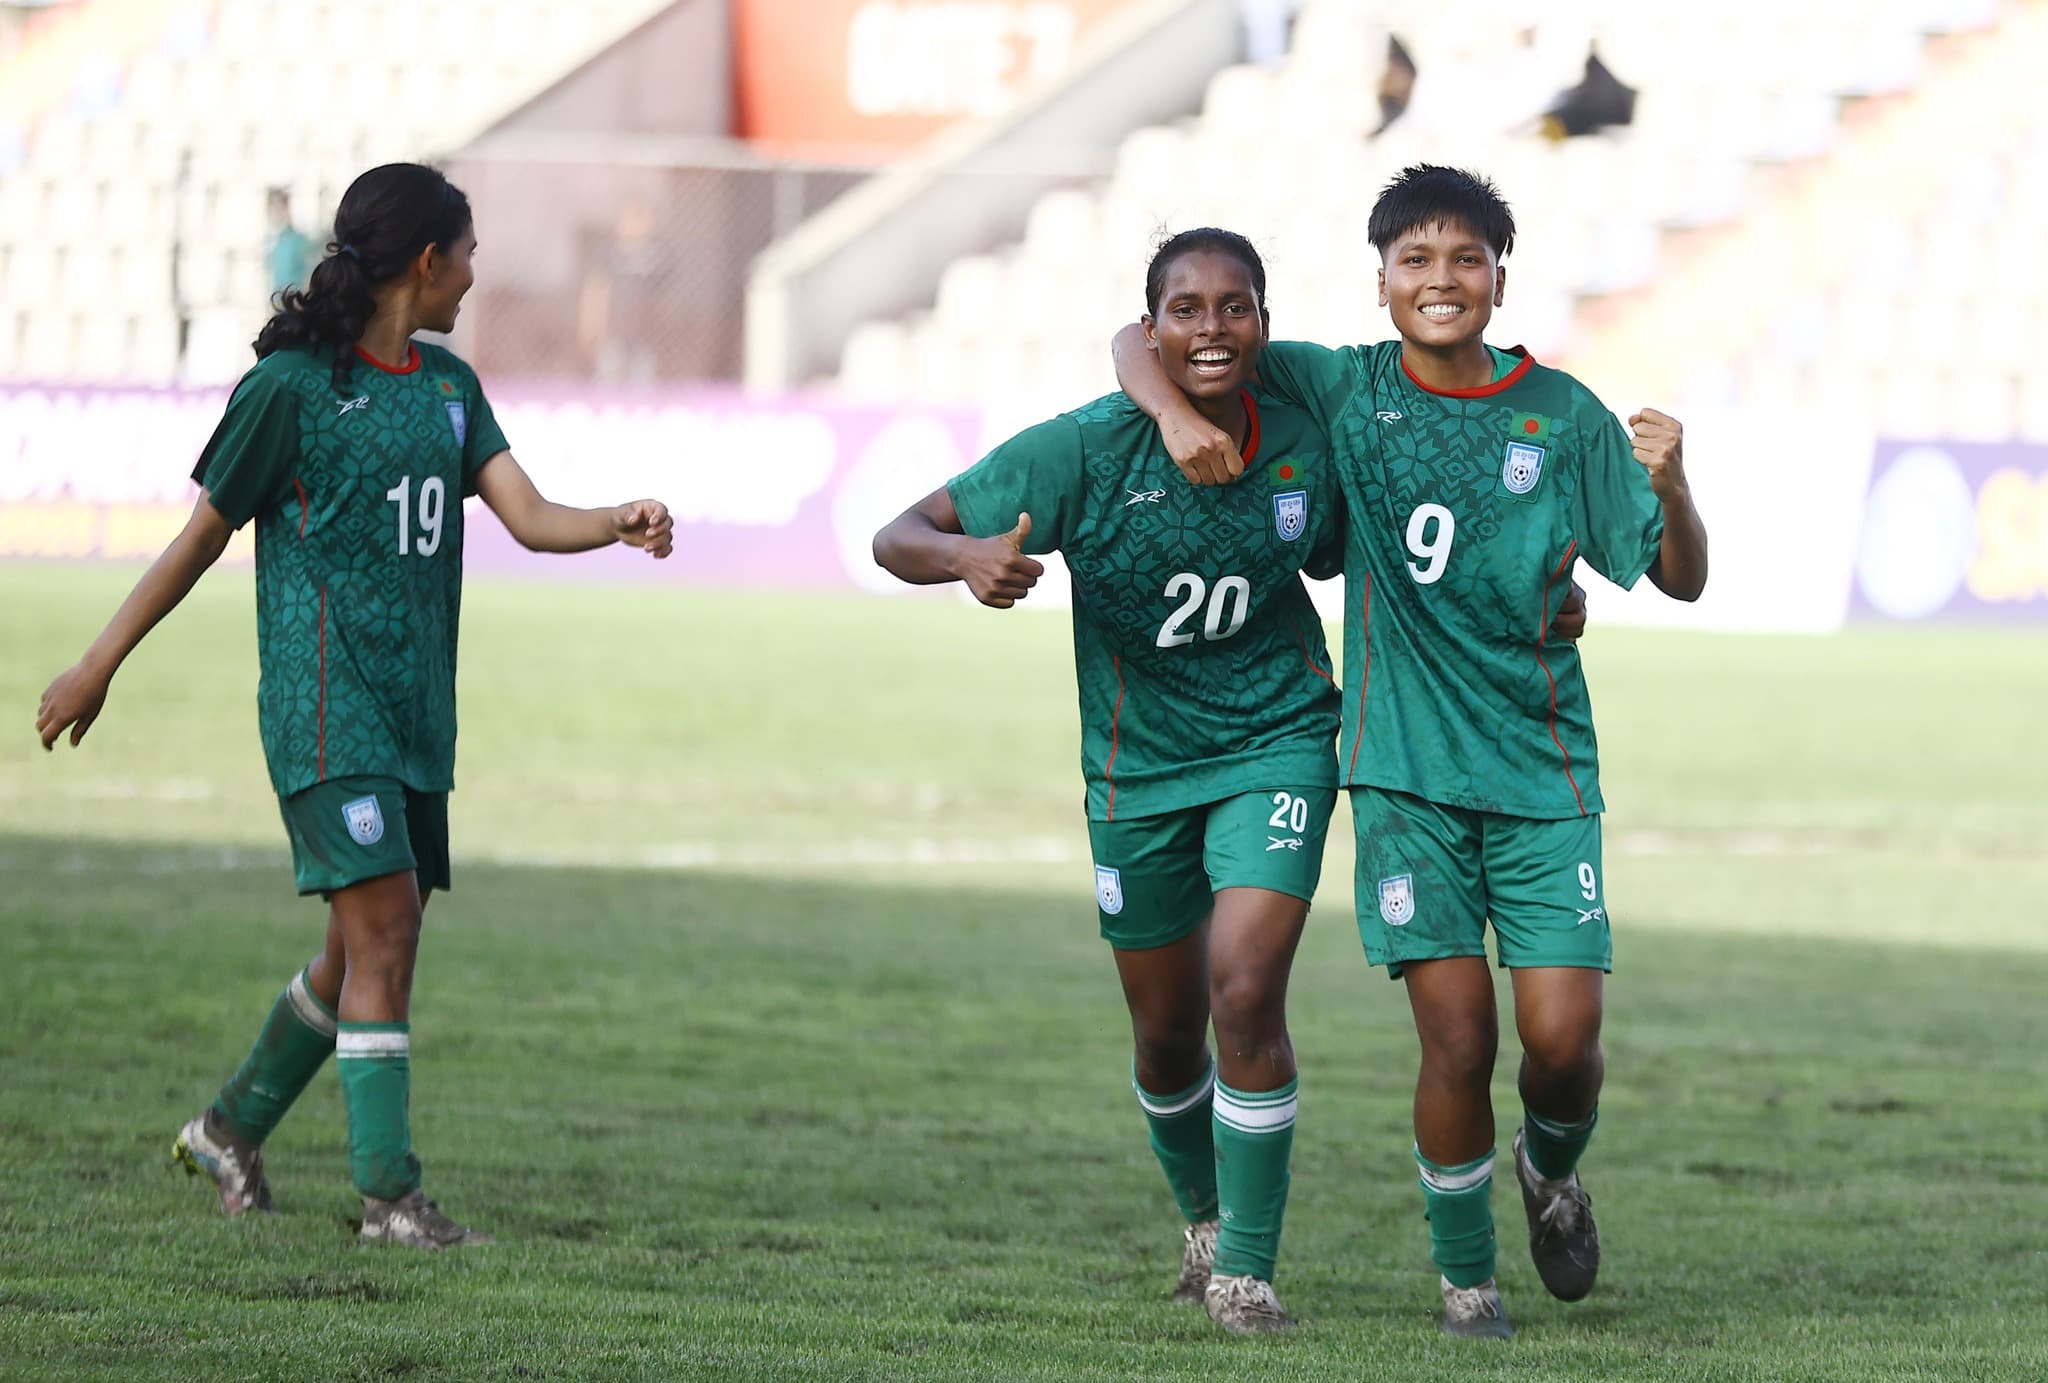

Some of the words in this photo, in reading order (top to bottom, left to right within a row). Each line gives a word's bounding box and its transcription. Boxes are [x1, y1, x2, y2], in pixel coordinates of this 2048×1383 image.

[386, 475, 445, 558] 19
[1405, 503, 1456, 585] 9
[1156, 572, 1251, 648] 20
[1269, 791, 1309, 833] 20
[1577, 862, 1597, 902] 9
